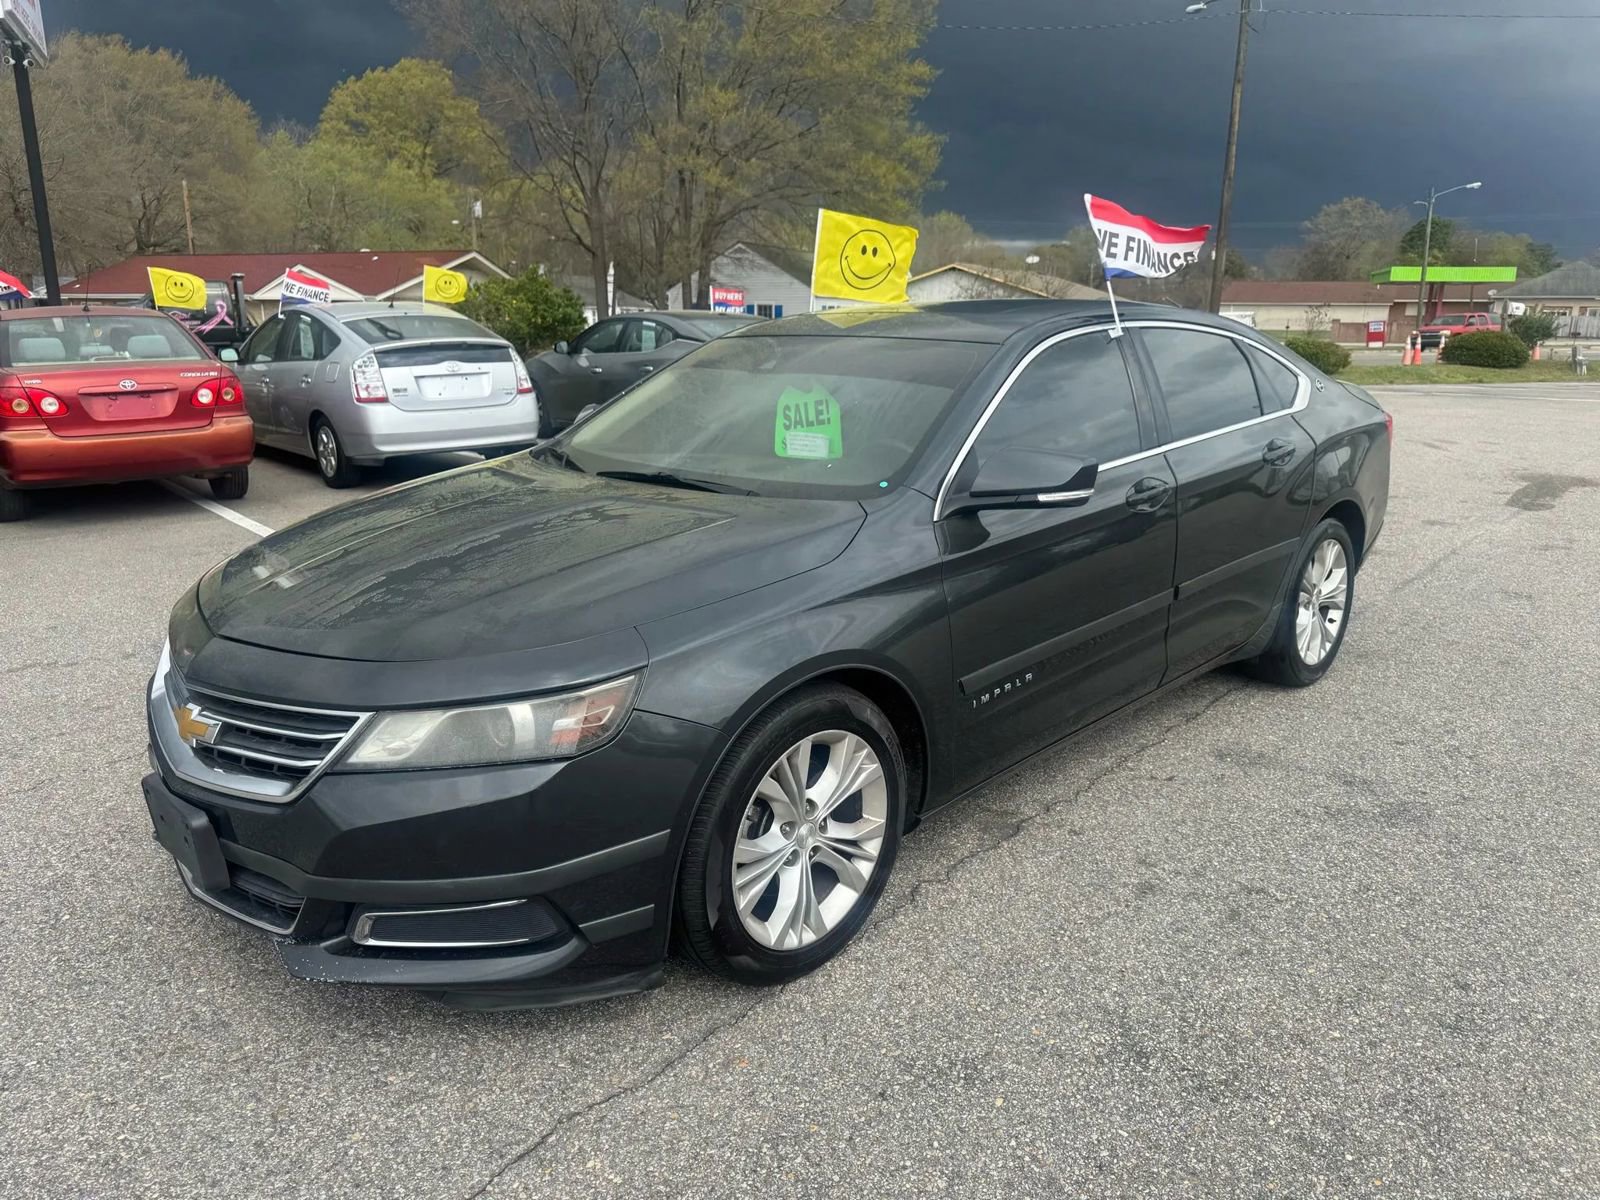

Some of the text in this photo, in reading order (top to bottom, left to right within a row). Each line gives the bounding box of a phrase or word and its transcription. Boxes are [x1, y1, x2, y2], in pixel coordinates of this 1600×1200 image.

[297, 286, 330, 303] FINANCE
[714, 291, 744, 301] BUY HERE
[783, 398, 831, 431] SALE!
[973, 672, 1033, 709] IMPALA
